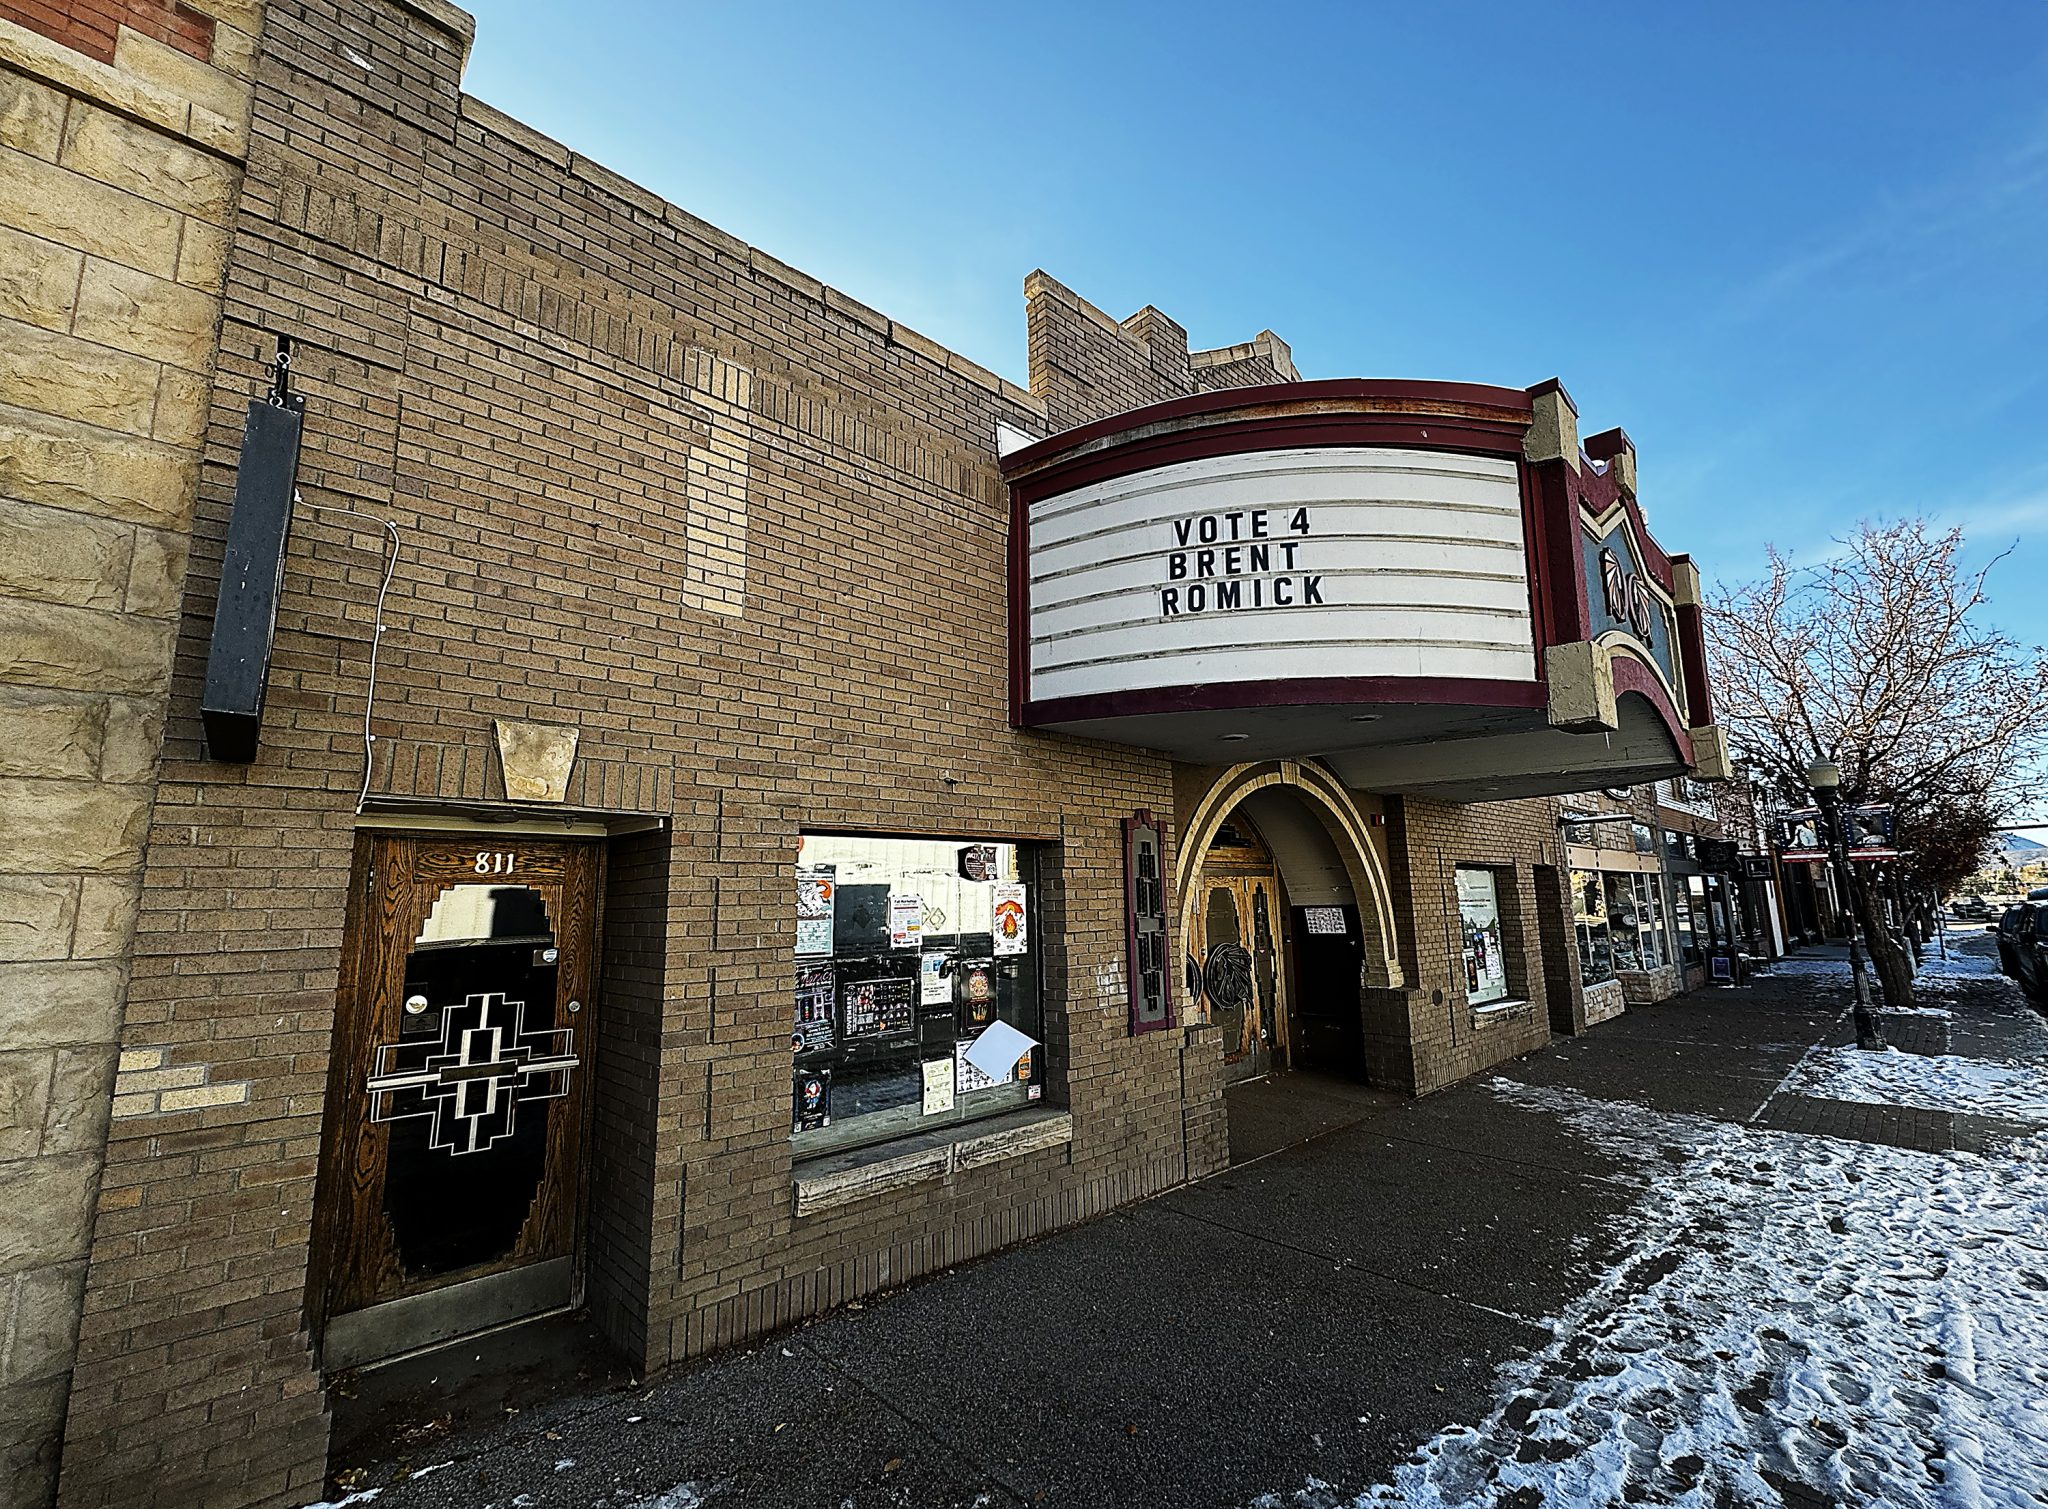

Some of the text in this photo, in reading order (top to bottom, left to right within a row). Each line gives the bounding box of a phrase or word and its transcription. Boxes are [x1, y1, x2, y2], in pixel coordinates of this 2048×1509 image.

[1173, 507, 1310, 547] VOTE 4
[1169, 542, 1299, 580] BRENT
[1161, 575, 1324, 616] ROMICK
[474, 852, 514, 875] 811
